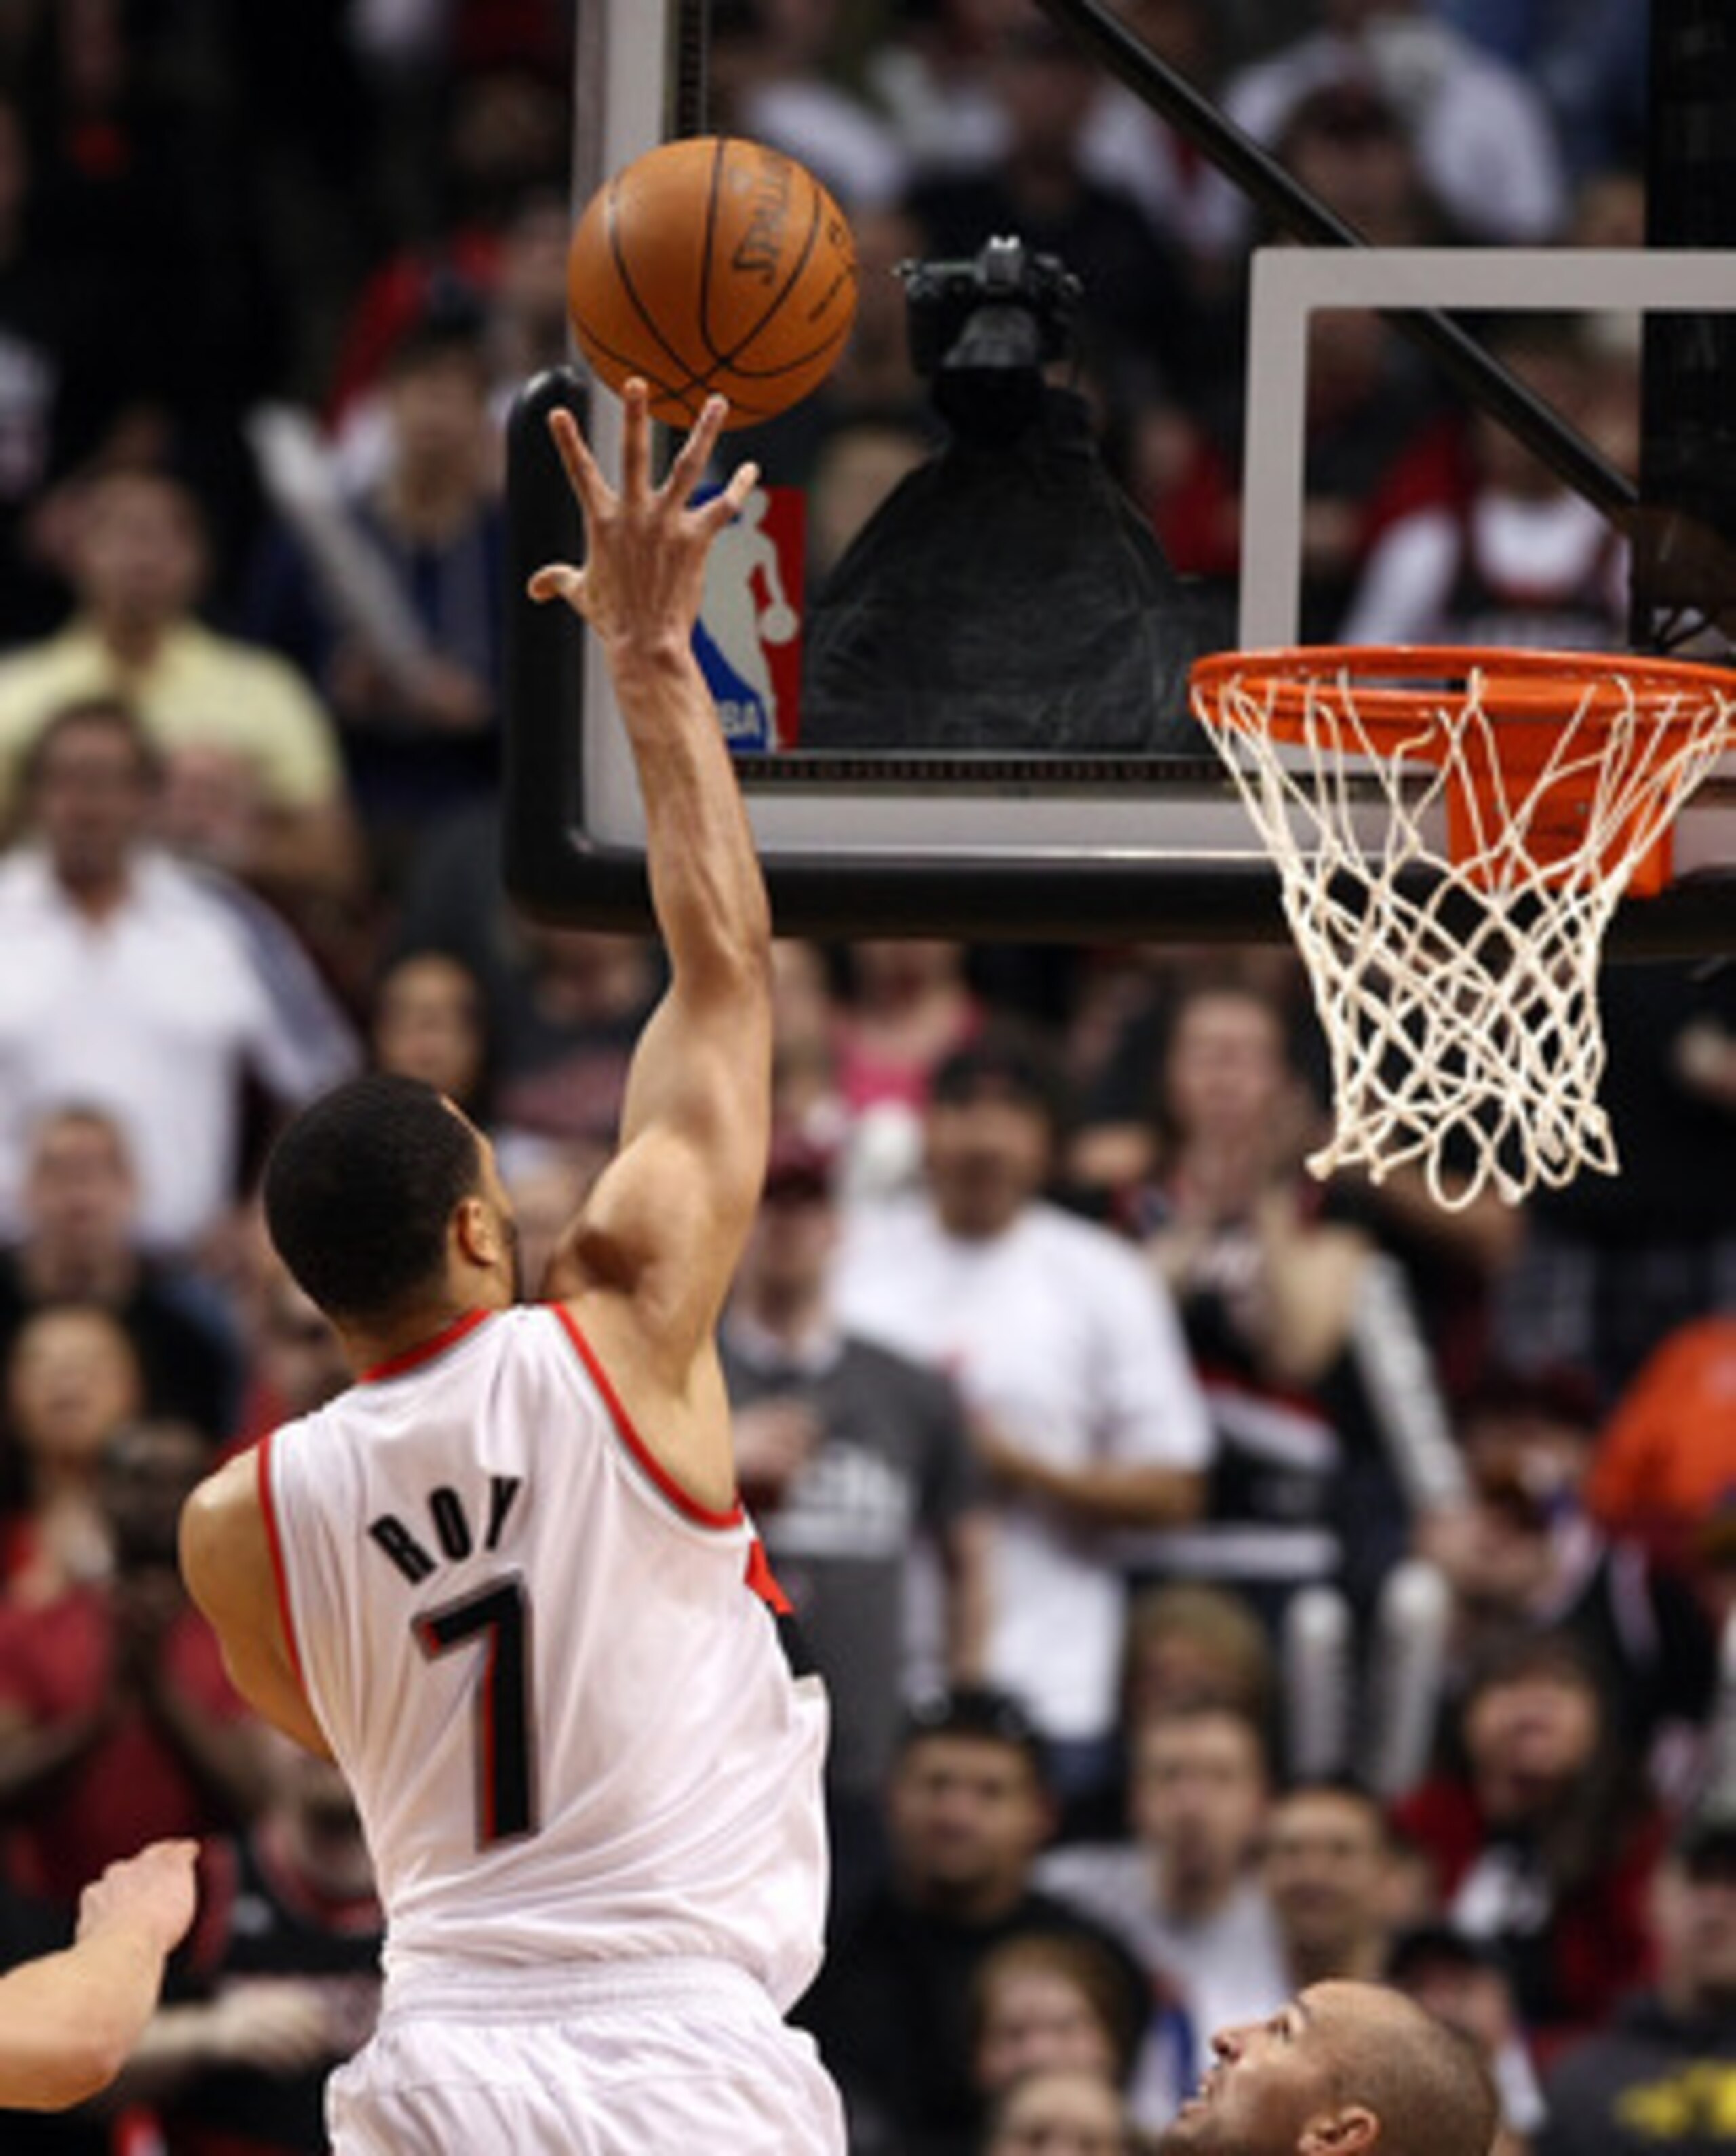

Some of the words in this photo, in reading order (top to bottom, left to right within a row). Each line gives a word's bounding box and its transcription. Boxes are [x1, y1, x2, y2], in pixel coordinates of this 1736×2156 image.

[719, 699, 759, 737] BA
[368, 1475, 521, 1586] ROY
[410, 1568, 541, 1853] 7
